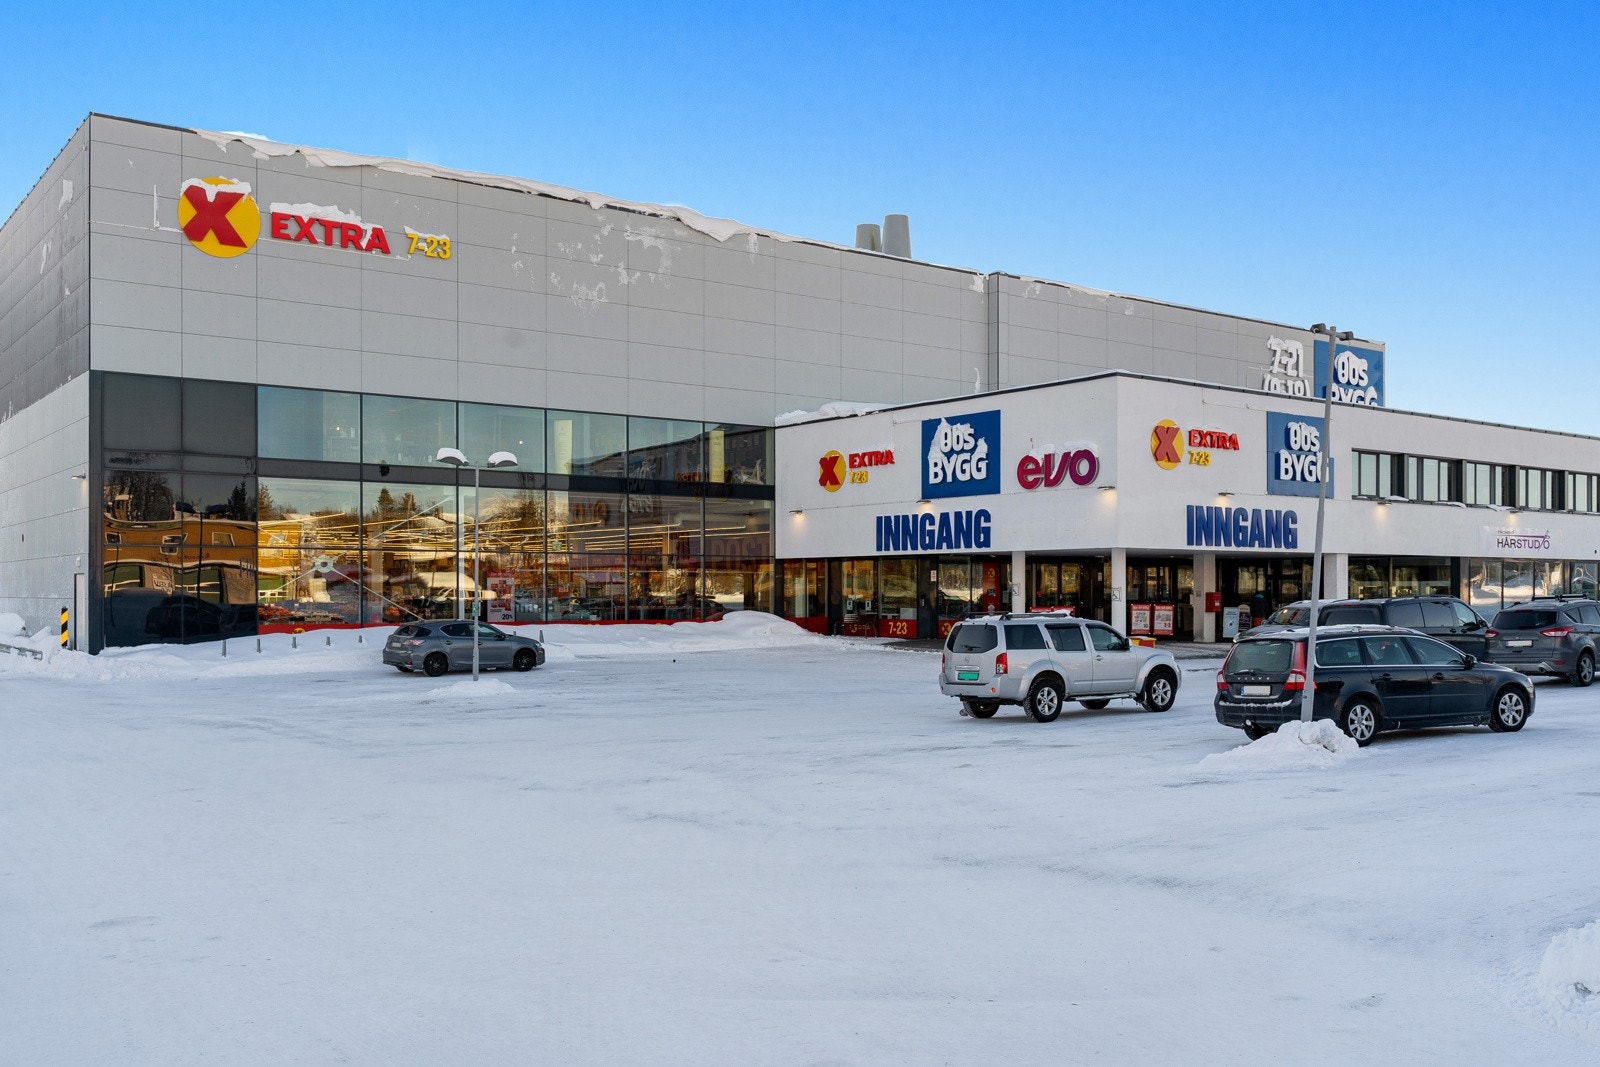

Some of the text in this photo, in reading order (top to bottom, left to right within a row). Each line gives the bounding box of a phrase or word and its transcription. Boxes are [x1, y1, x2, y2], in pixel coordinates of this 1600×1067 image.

[270, 212, 391, 255] EXTRA
[406, 232, 452, 260] 7-23
[1188, 428, 1240, 451] EXTRA
[848, 449, 895, 469] EXTRA
[929, 451, 989, 485] BYGG
[1016, 449, 1099, 490] evo
[875, 509, 992, 553] INNGANG
[1186, 504, 1298, 550] INNGANG
[888, 621, 908, 635] 7-23
